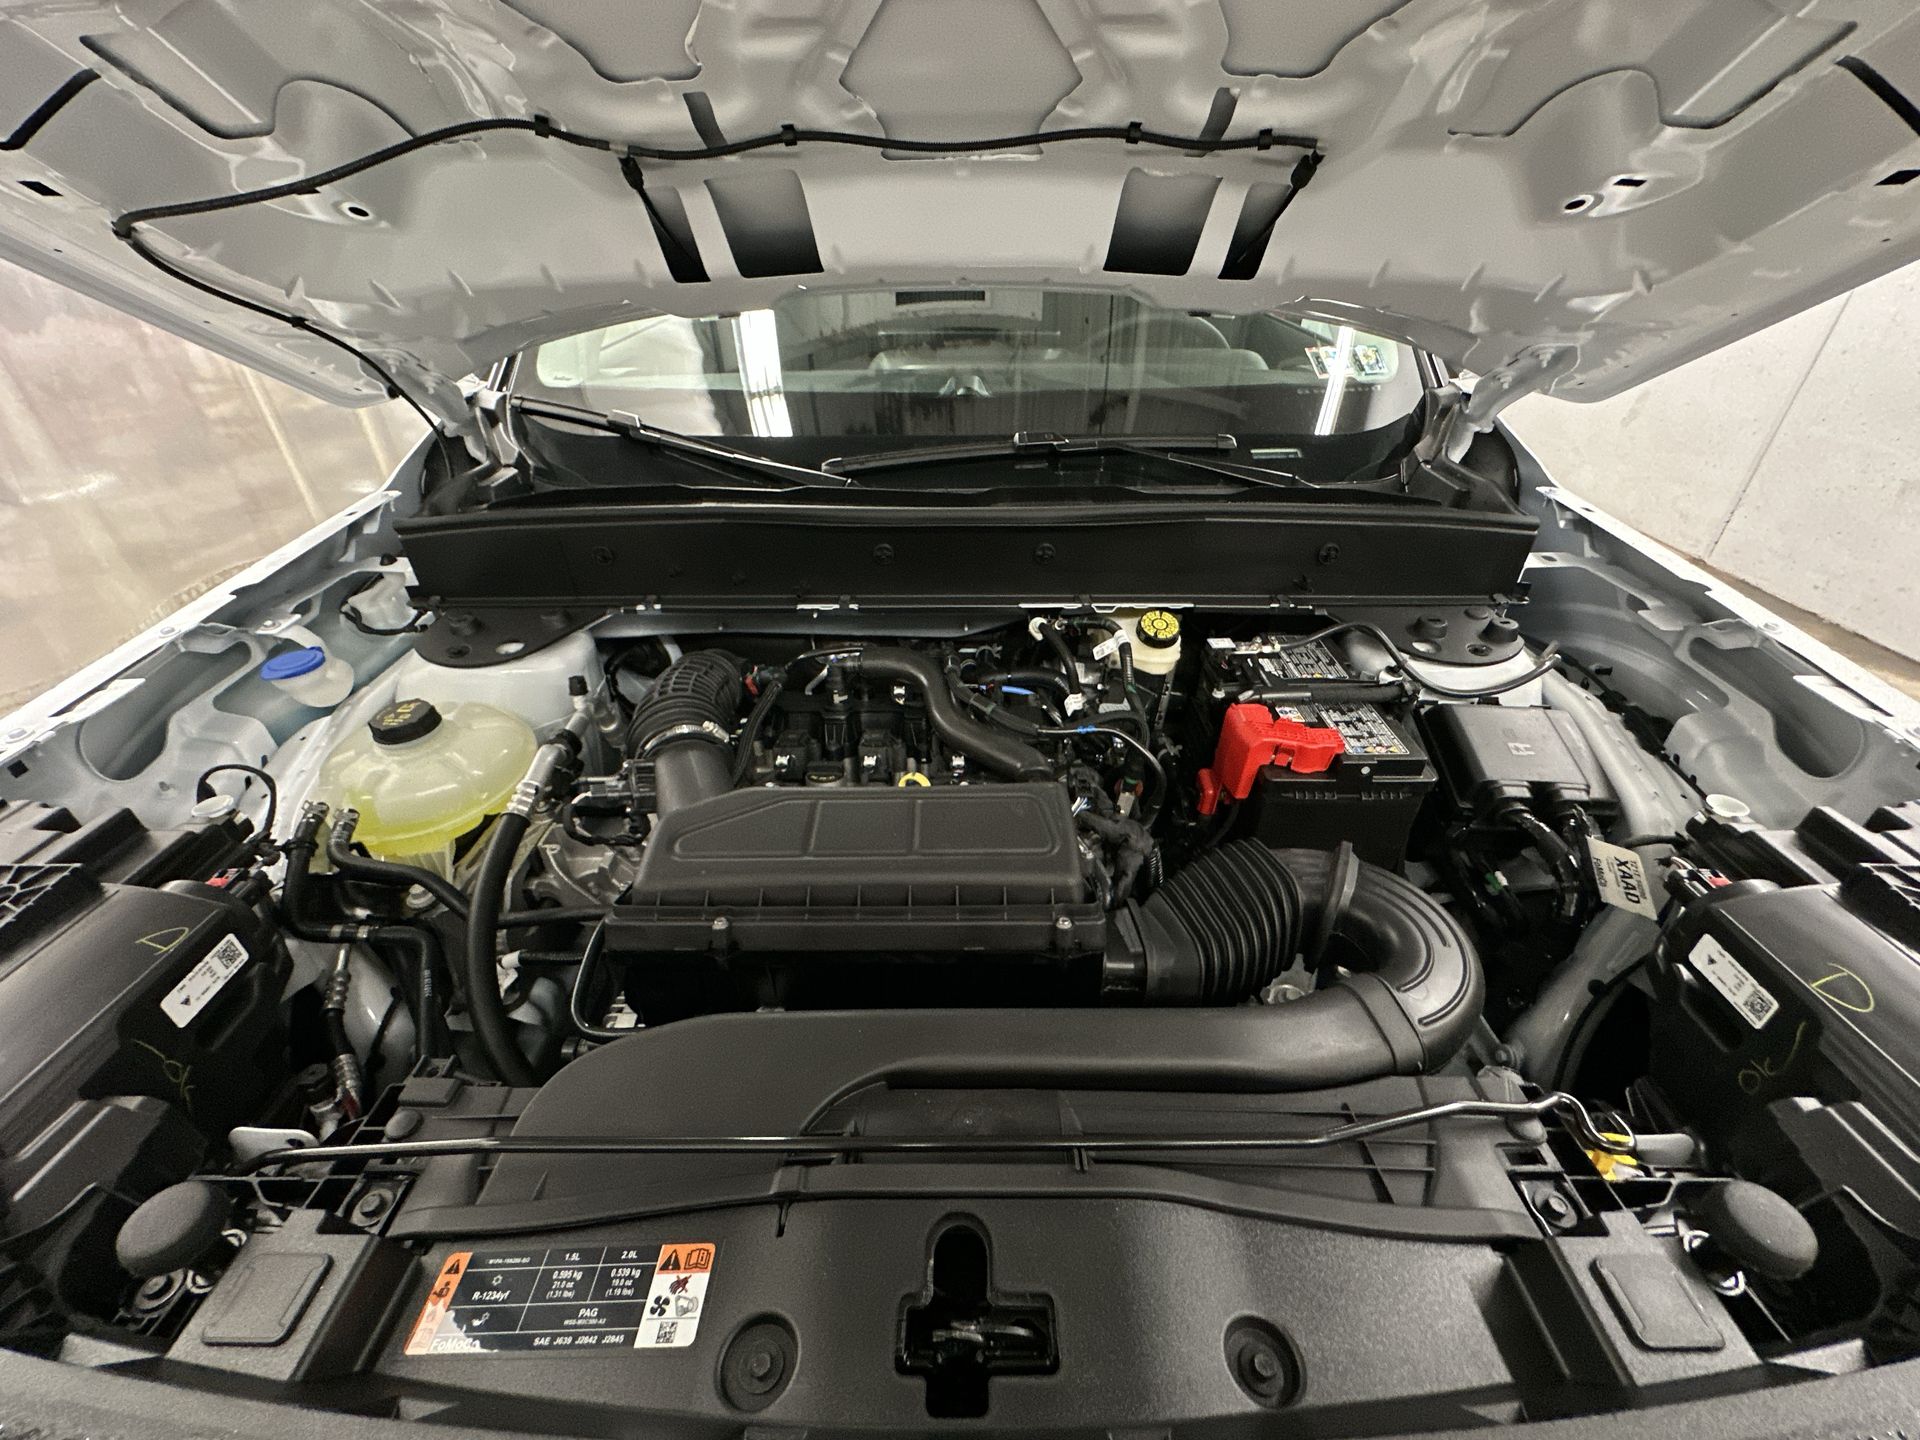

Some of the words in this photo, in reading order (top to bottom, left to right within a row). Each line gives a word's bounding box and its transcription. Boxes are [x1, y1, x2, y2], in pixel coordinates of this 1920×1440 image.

[1613, 855, 1641, 904] XAAD
[565, 1252, 581, 1261] 1.5L
[621, 1250, 638, 1260] 2.0L
[572, 1270, 583, 1281] kg
[610, 1267, 631, 1278] 0.539
[630, 1267, 641, 1279] kg
[471, 1289, 512, 1302] R-1234yf
[578, 1307, 599, 1318] PAG
[429, 1337, 481, 1353] FoMoCo
[533, 1336, 552, 1347] SAE
[553, 1335, 573, 1346] J639
